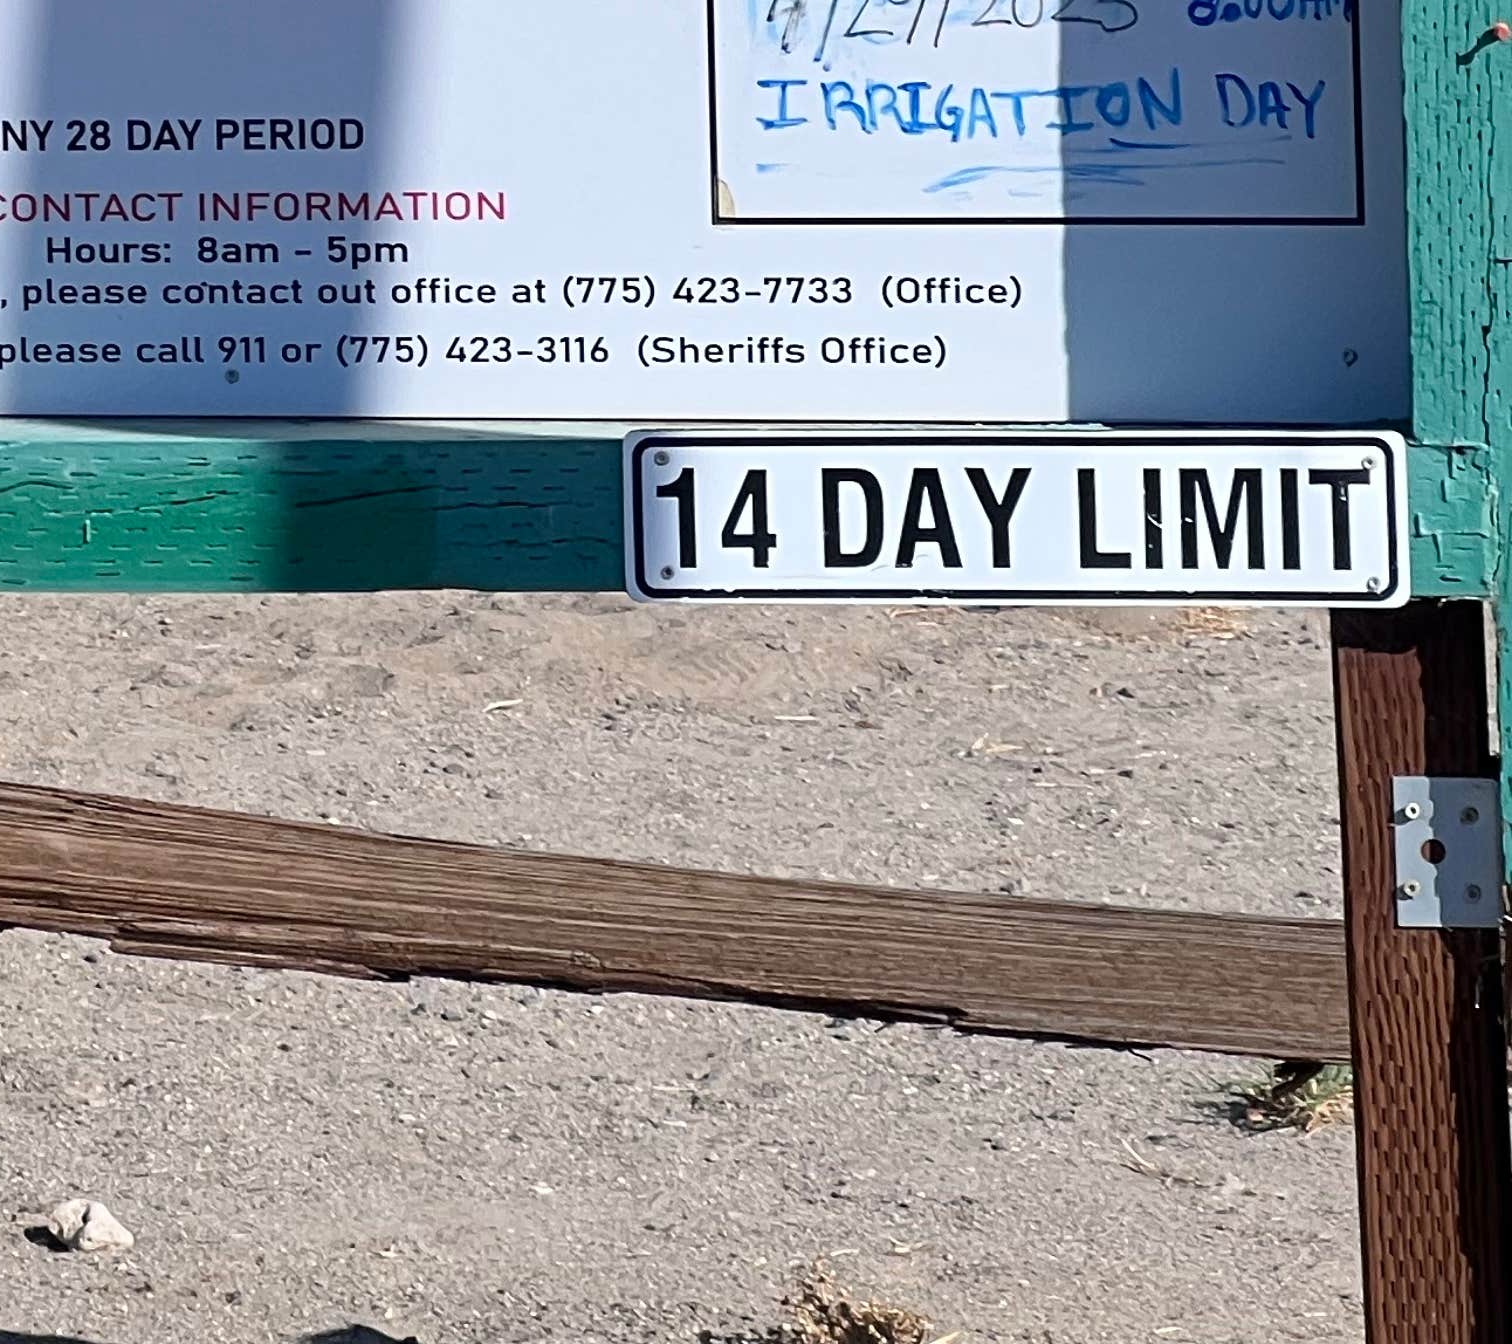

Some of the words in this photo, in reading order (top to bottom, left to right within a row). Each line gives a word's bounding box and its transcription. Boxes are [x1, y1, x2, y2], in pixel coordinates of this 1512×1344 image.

[1215, 73, 1326, 139] DAY
[66, 120, 111, 151] 28
[127, 119, 202, 150] DAY
[215, 119, 363, 150] PERIOD
[199, 192, 504, 221] INFORMATION
[47, 237, 171, 264] Hours:
[198, 237, 279, 263] 8am
[328, 236, 408, 270] 5pm
[23, 278, 147, 311] please
[163, 280, 303, 304] contact
[318, 280, 376, 304] out
[392, 278, 496, 303] office
[512, 280, 546, 303] at
[563, 275, 654, 308] (775)
[673, 277, 852, 303] 423-7733
[882, 276, 1021, 308] (Office)
[137, 337, 204, 363] call
[218, 337, 265, 363] 911
[282, 344, 322, 363] or
[337, 334, 427, 368] (775)
[446, 337, 608, 363] 423-3116
[638, 335, 805, 367] (Sheriffs
[821, 335, 946, 368] Office)
[656, 467, 777, 568] 14
[821, 467, 1032, 568] DAY
[1077, 467, 1373, 570] LIMIT
